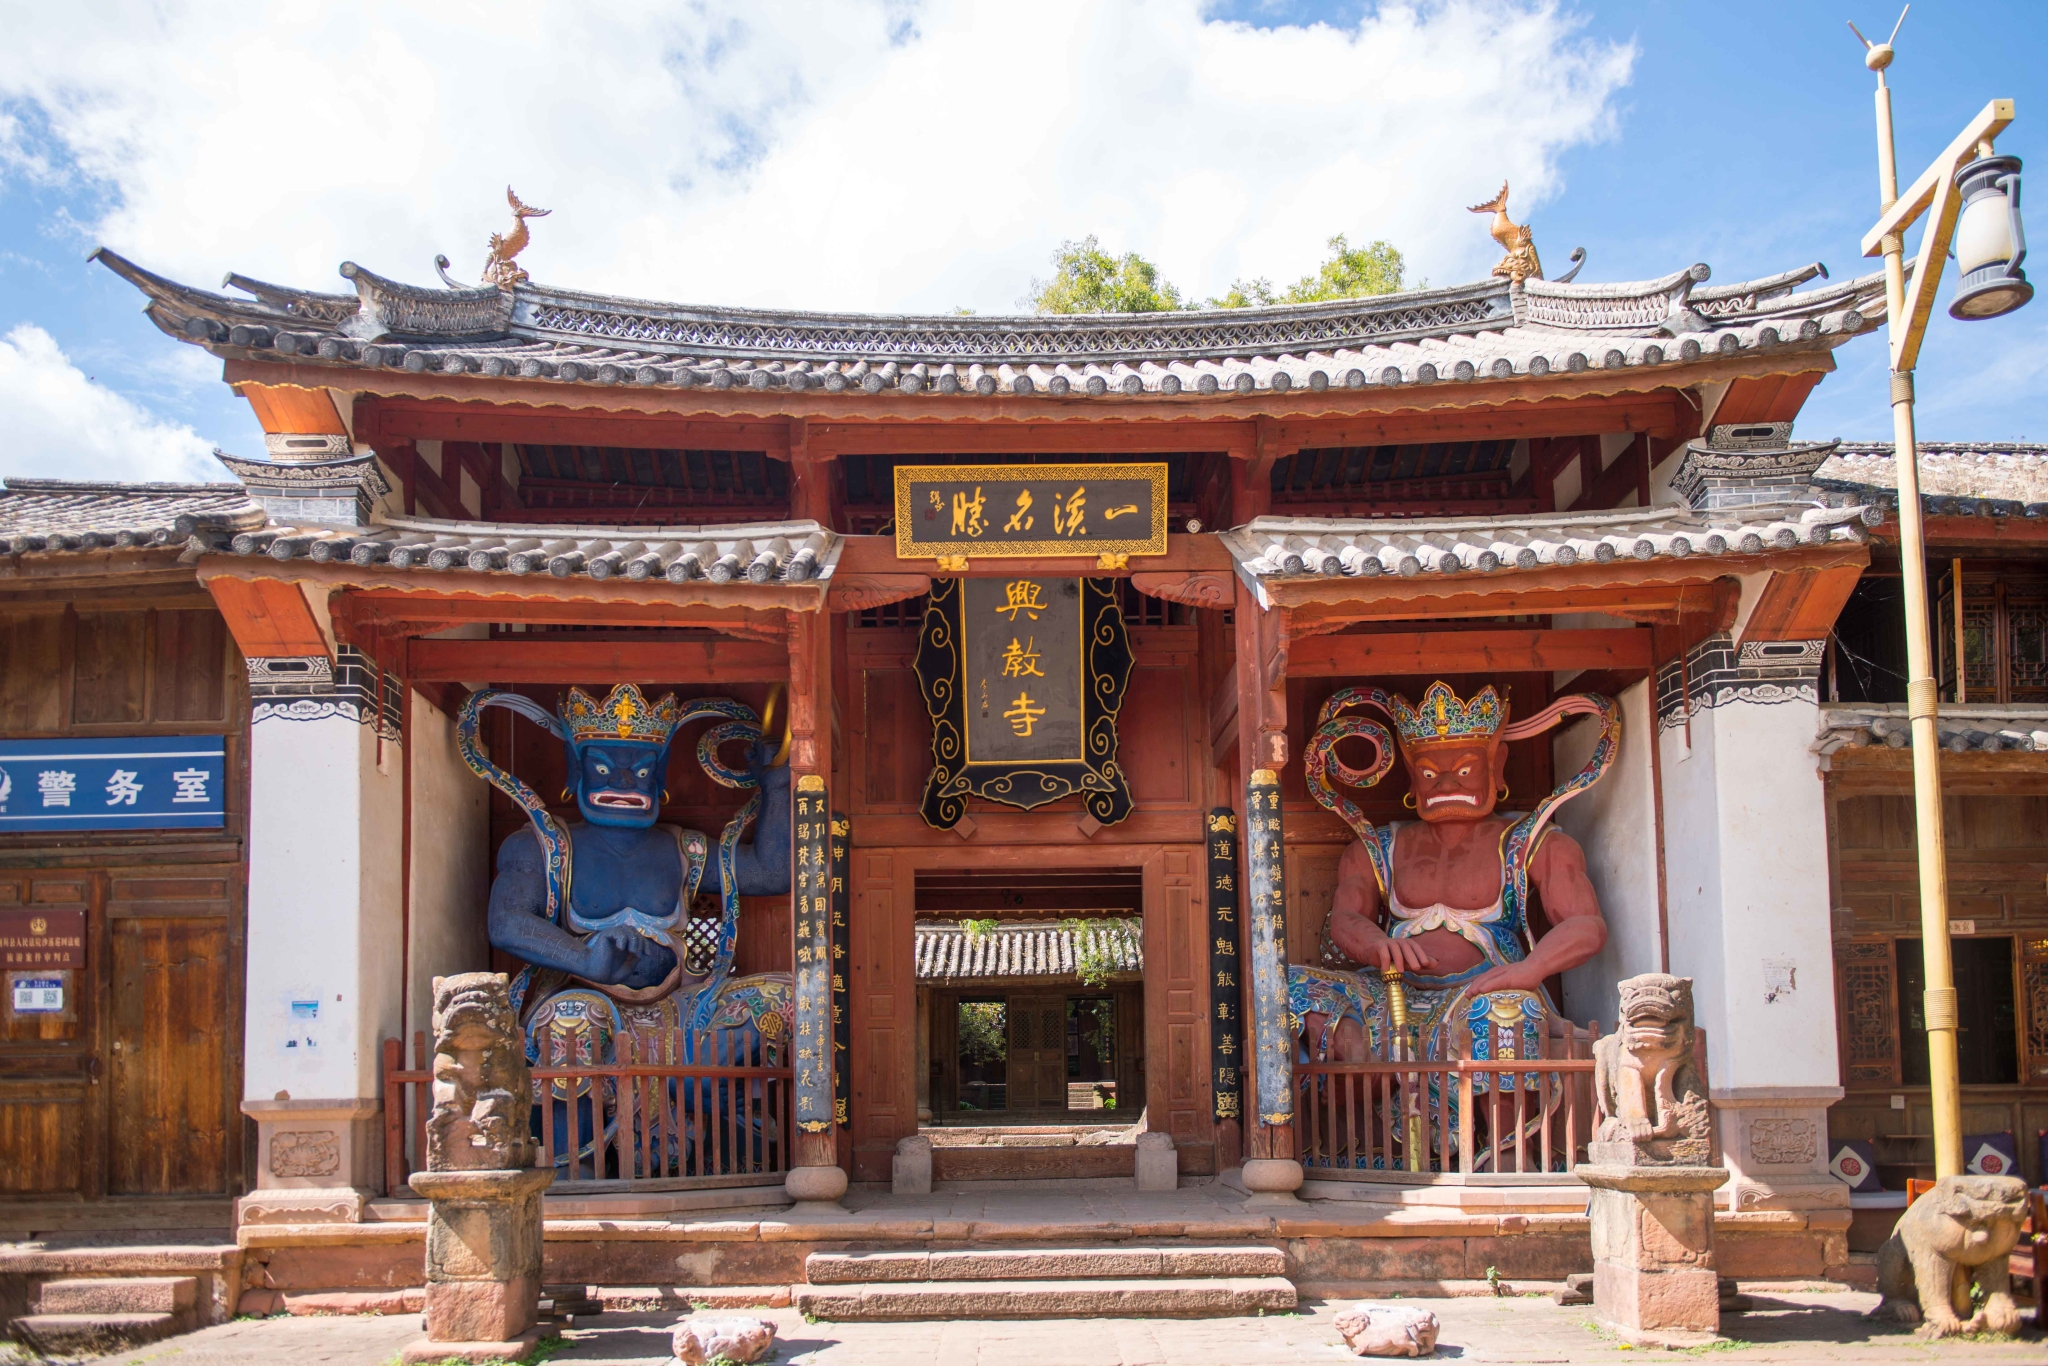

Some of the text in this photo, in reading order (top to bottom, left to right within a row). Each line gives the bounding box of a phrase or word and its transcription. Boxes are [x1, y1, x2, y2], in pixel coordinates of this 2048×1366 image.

[996, 580, 1048, 737] 興教寺
[38, 768, 211, 807] 警务室
